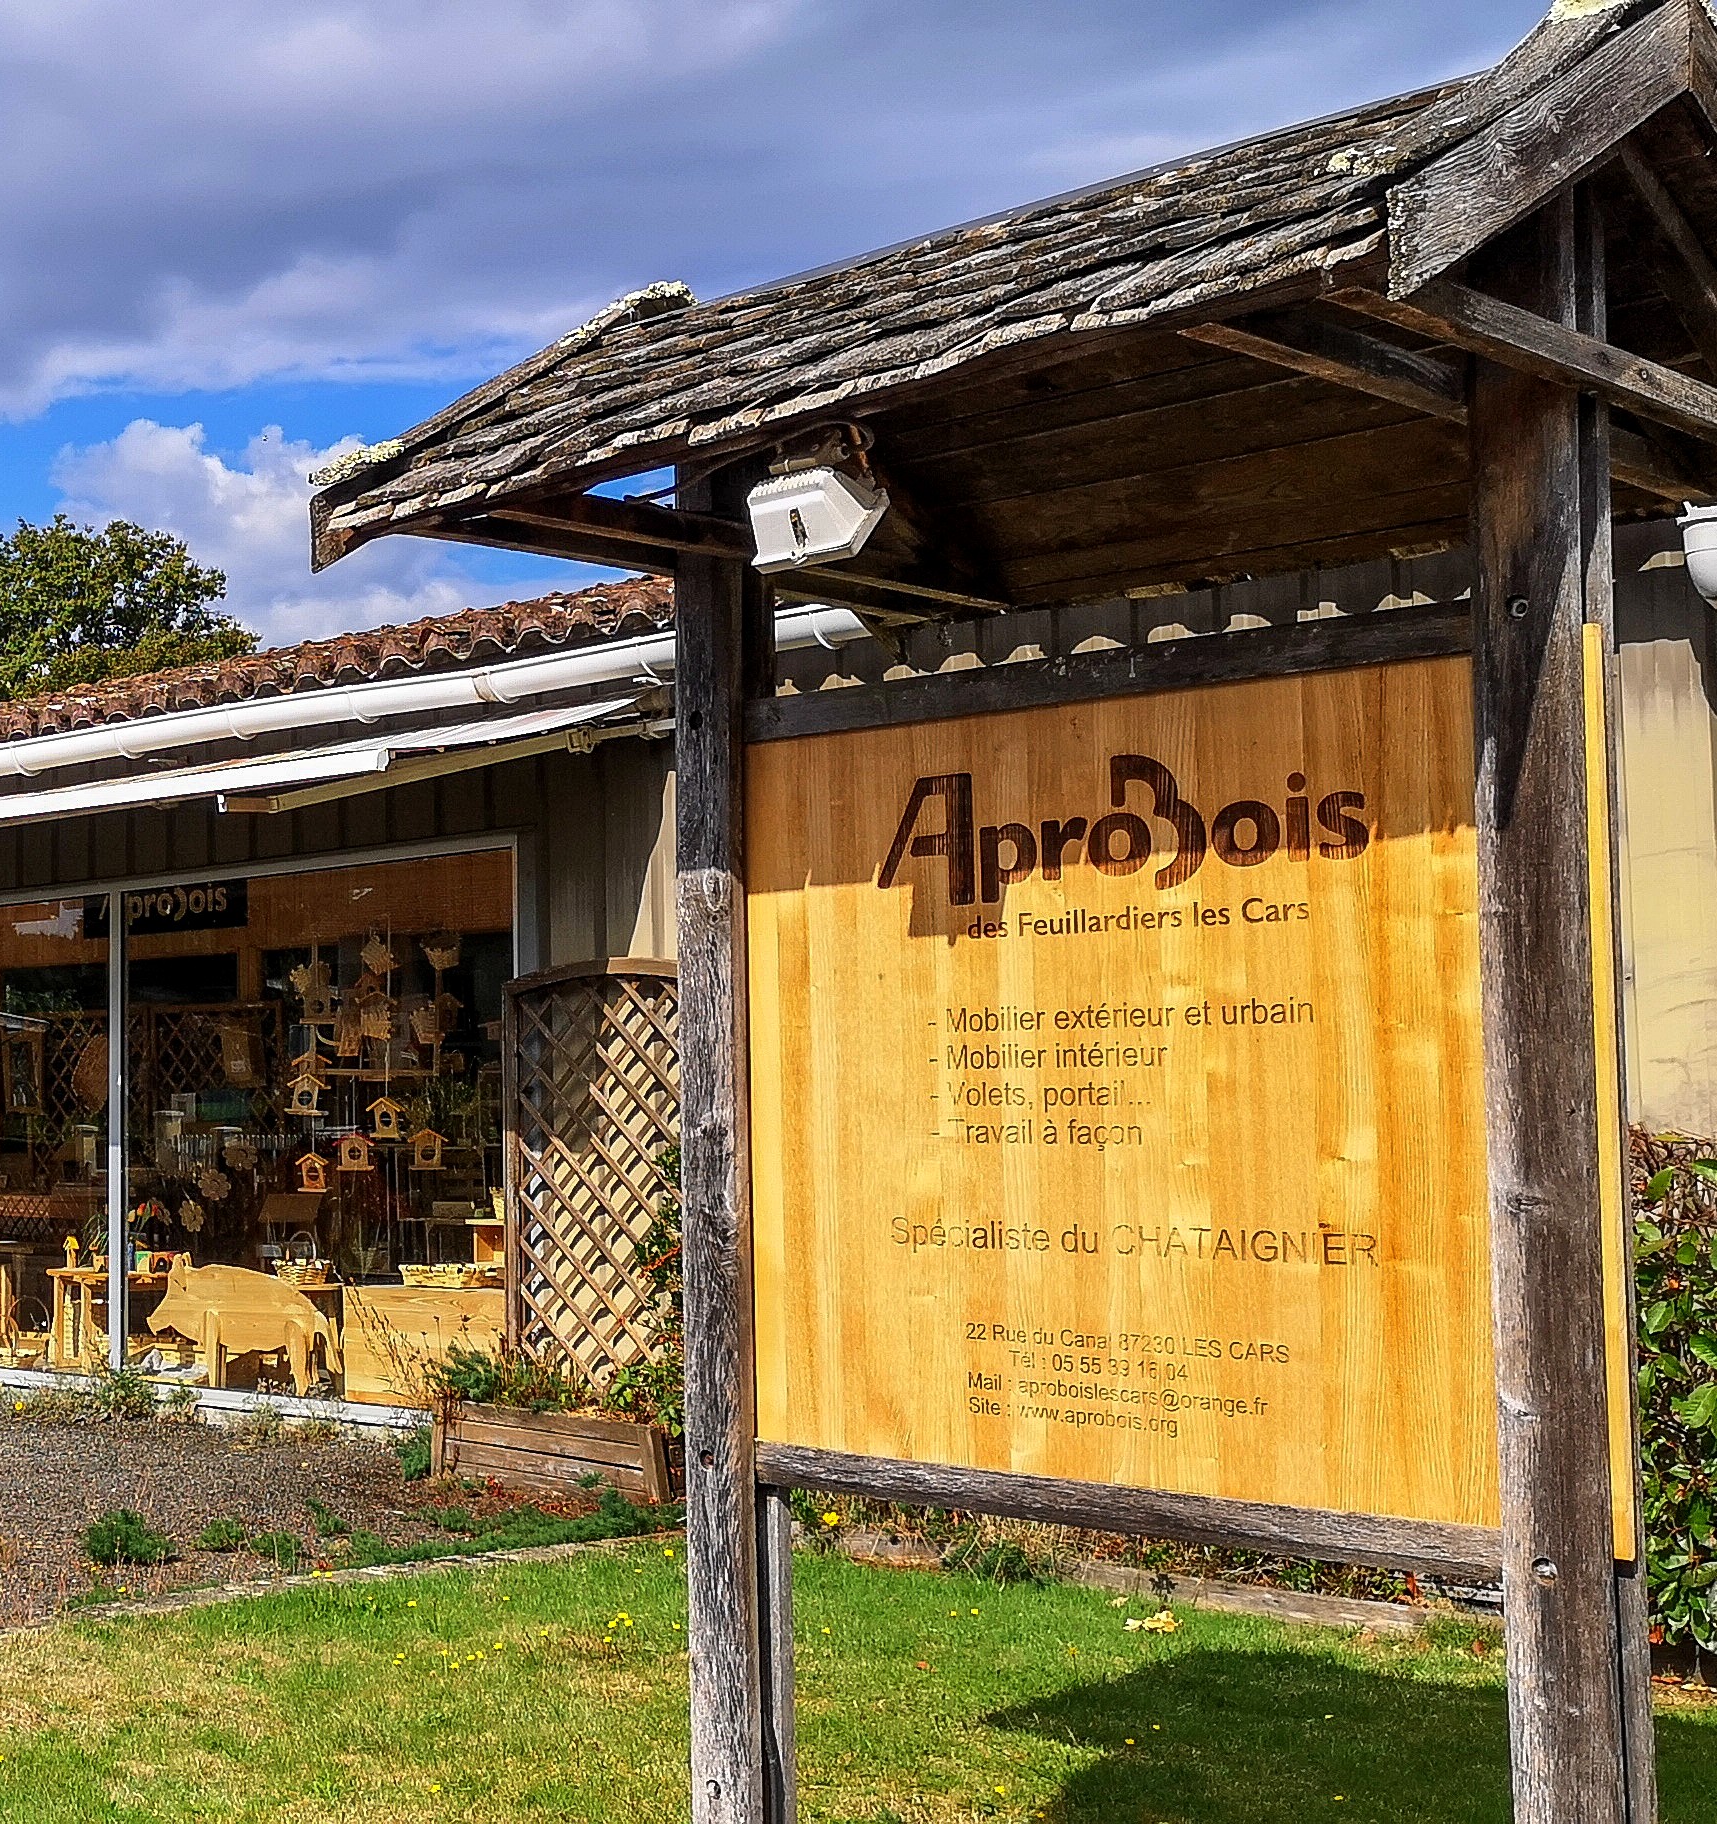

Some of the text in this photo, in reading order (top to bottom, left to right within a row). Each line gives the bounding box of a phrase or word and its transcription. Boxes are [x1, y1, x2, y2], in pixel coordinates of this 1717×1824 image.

[967, 897, 1310, 939] des Feuillardiers les Cars
[946, 1006, 1045, 1033] Mobilier
[1054, 1000, 1175, 1029] extérieur
[1185, 1003, 1212, 1026] et
[1222, 997, 1314, 1025] urbain
[946, 1043, 1046, 1070] Mobilier
[1055, 1041, 1168, 1068] intérieur
[948, 1081, 1033, 1109] Volets,
[948, 1118, 1032, 1144] Travail
[1043, 1119, 1059, 1144] à
[1068, 1119, 1142, 1151] façon
[890, 1217, 1379, 1267] Spécialiste du CHATAIGNIER
[966, 1323, 986, 1340] 22
[993, 1324, 1026, 1343] Rue
[1033, 1328, 1054, 1345] du
[1119, 1334, 1174, 1354] 87230
[1183, 1337, 1222, 1358] LES
[1229, 1341, 1290, 1363] CARS
[1052, 1354, 1074, 1372] 05
[1080, 1356, 1101, 1374] 55
[1166, 1363, 1188, 1381] 04
[968, 1372, 1001, 1391] Mail
[1019, 1379, 1268, 1417] aproboislescars@orange.fr
[969, 1397, 1001, 1415] Site
